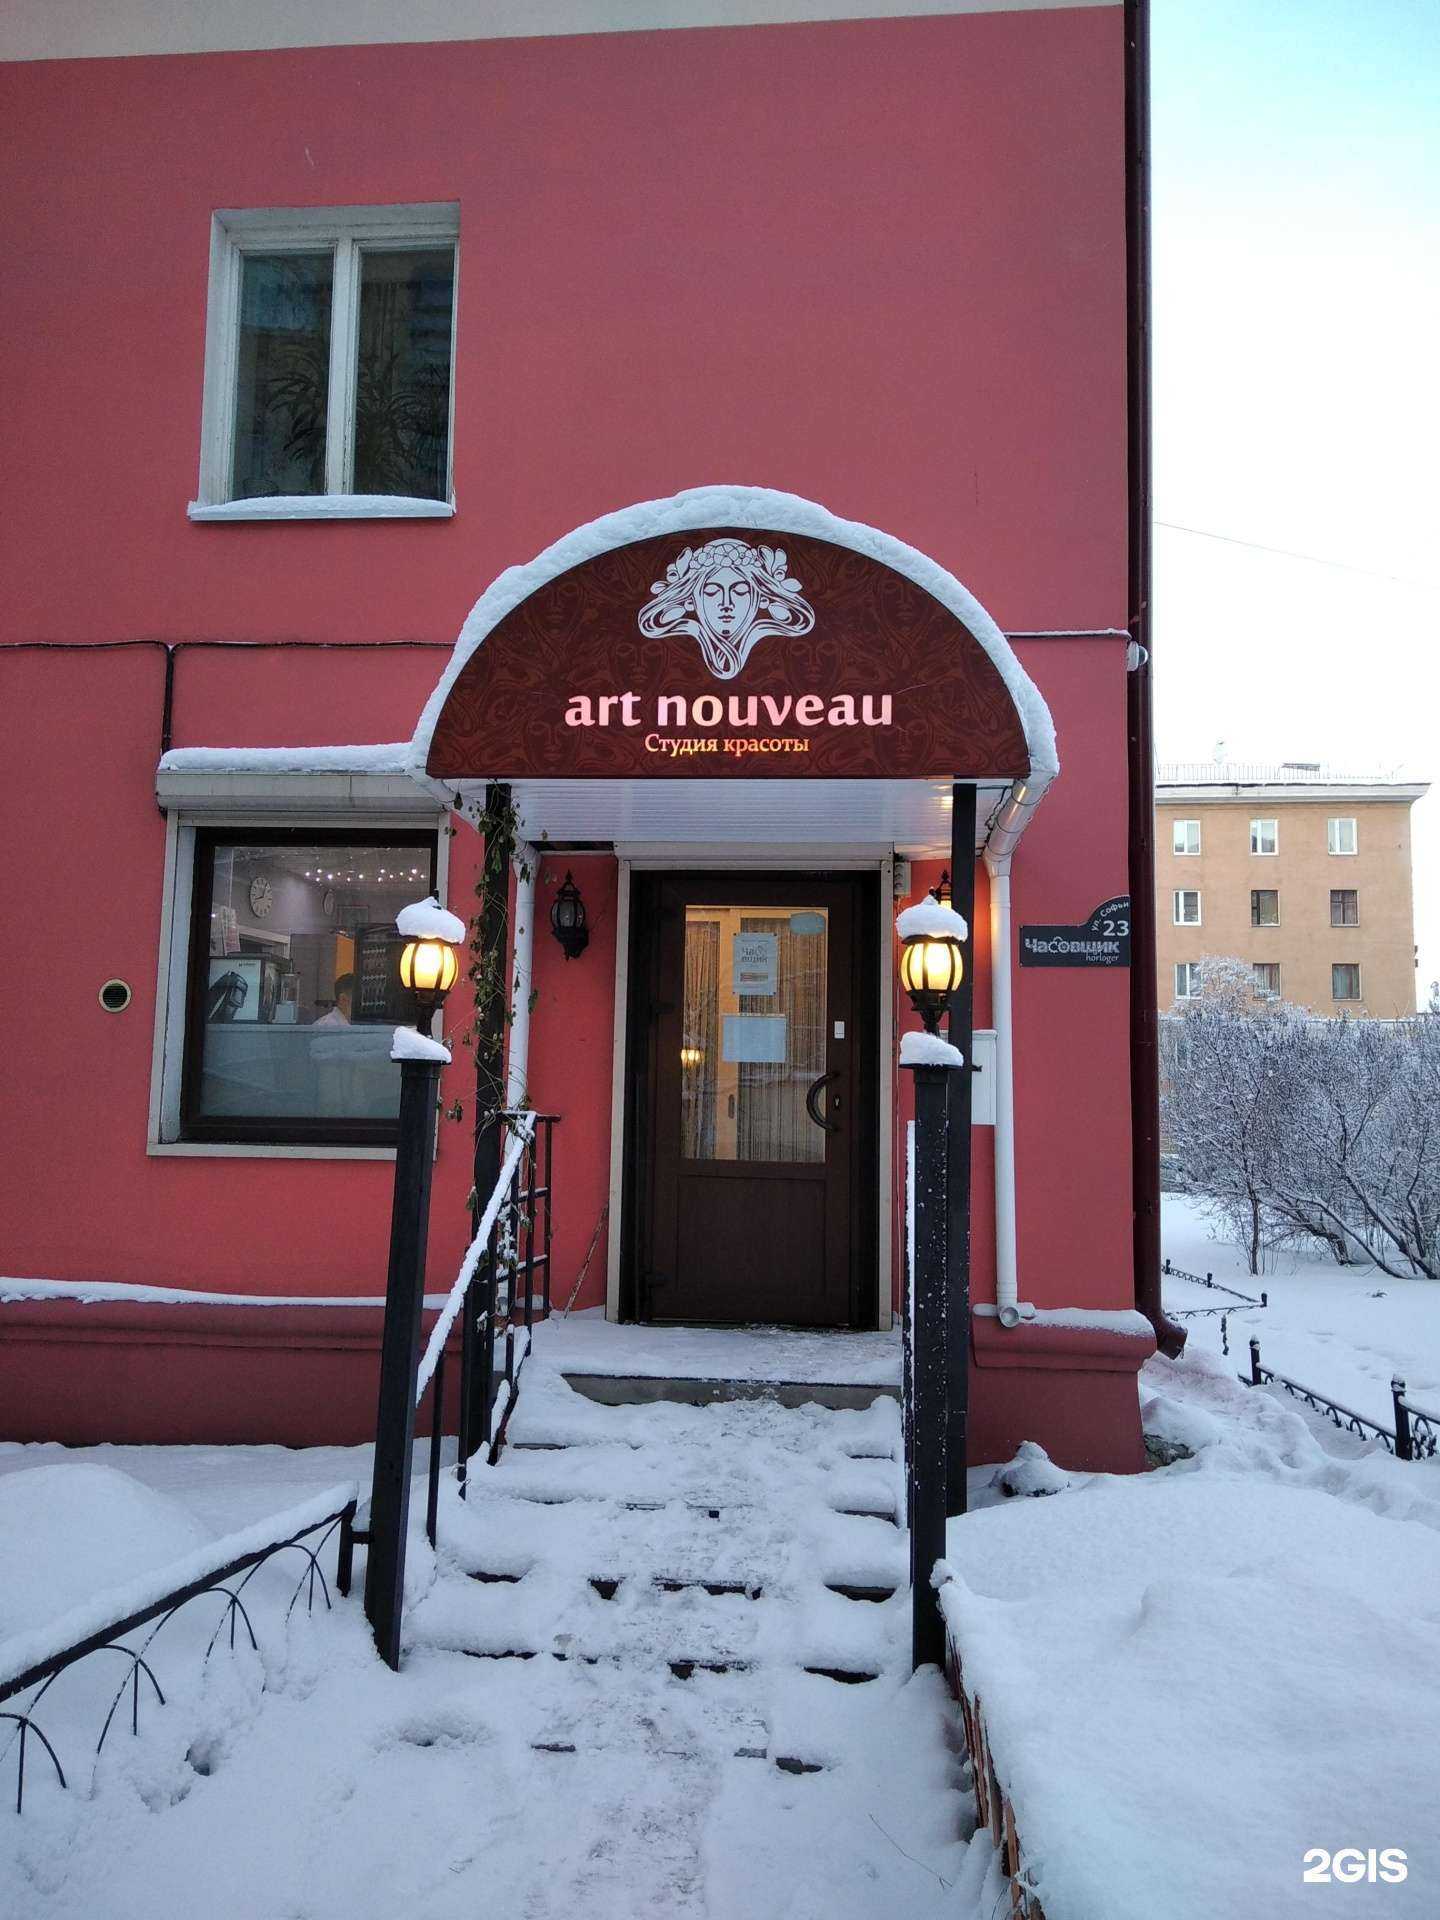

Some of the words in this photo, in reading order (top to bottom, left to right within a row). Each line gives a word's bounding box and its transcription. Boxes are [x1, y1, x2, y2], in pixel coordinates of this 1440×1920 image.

[564, 691, 641, 727] art
[657, 694, 893, 727] nouveau
[644, 733, 719, 757] Студия
[722, 737, 810, 757] красоты
[1103, 920, 1129, 936] 23
